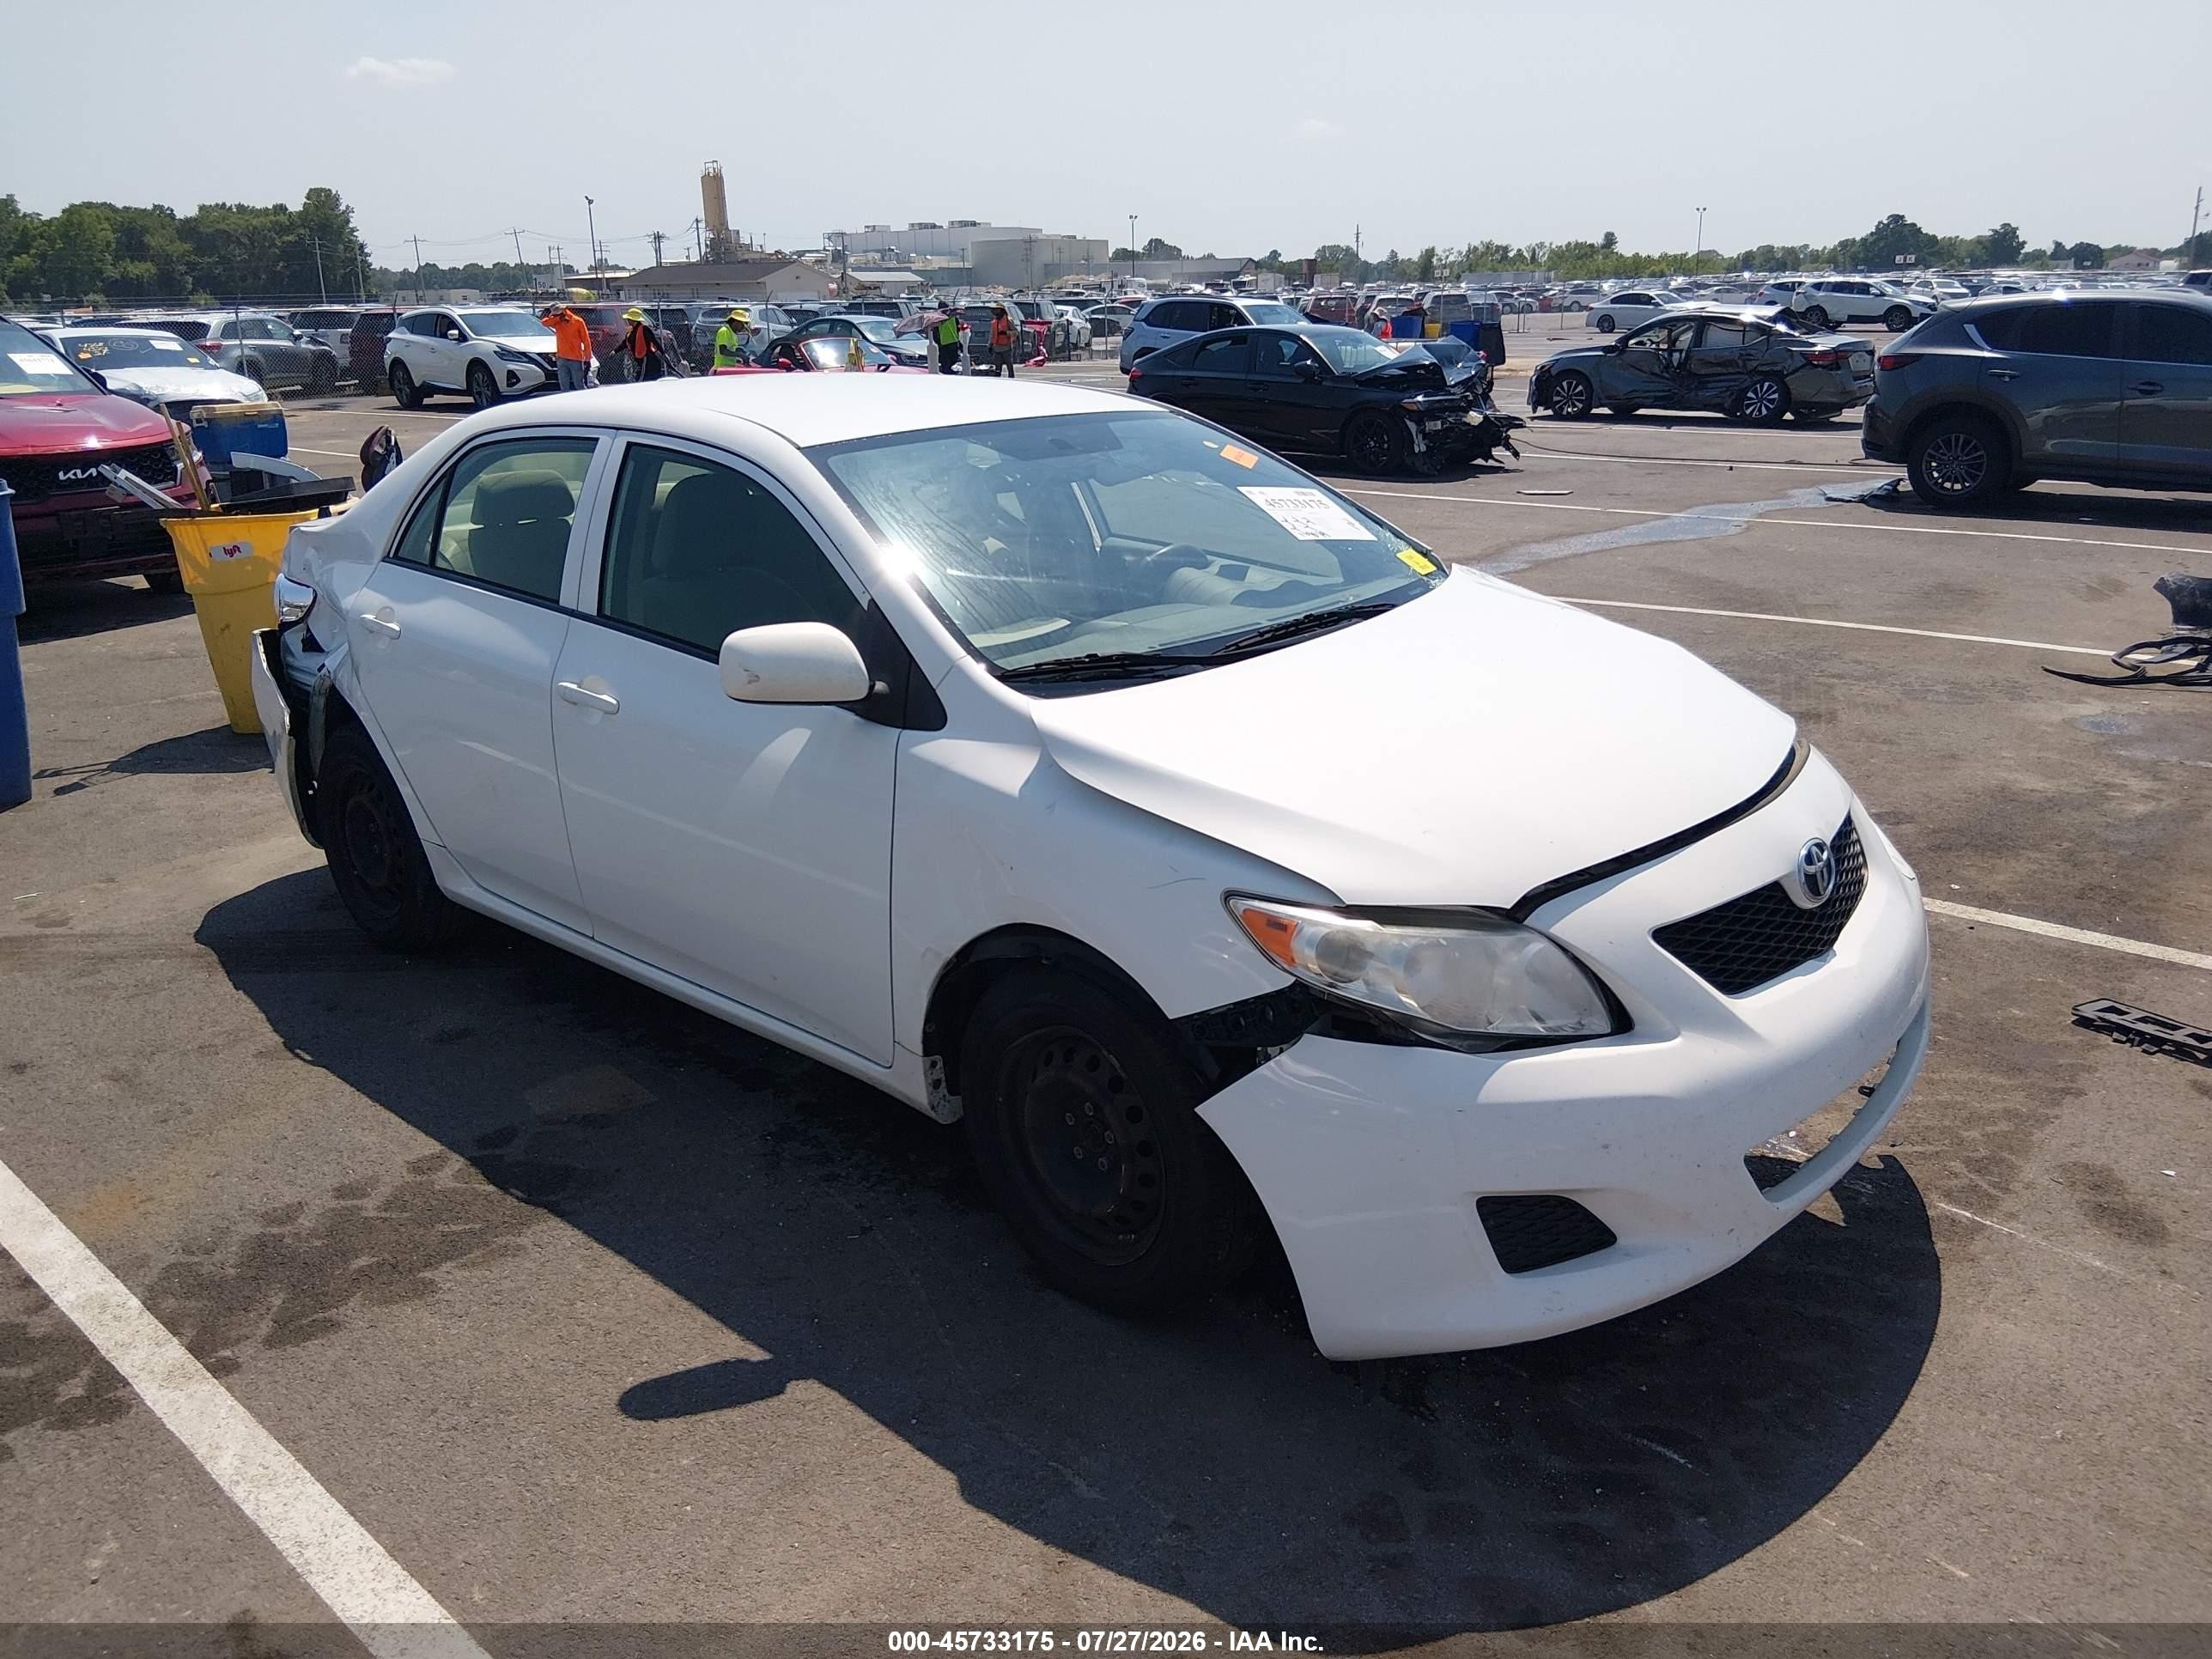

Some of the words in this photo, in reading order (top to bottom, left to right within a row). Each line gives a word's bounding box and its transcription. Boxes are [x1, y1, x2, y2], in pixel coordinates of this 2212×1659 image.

[58, 468, 97, 480] KIA
[1264, 498, 1330, 509] 45733175
[222, 544, 242, 558] lyft
